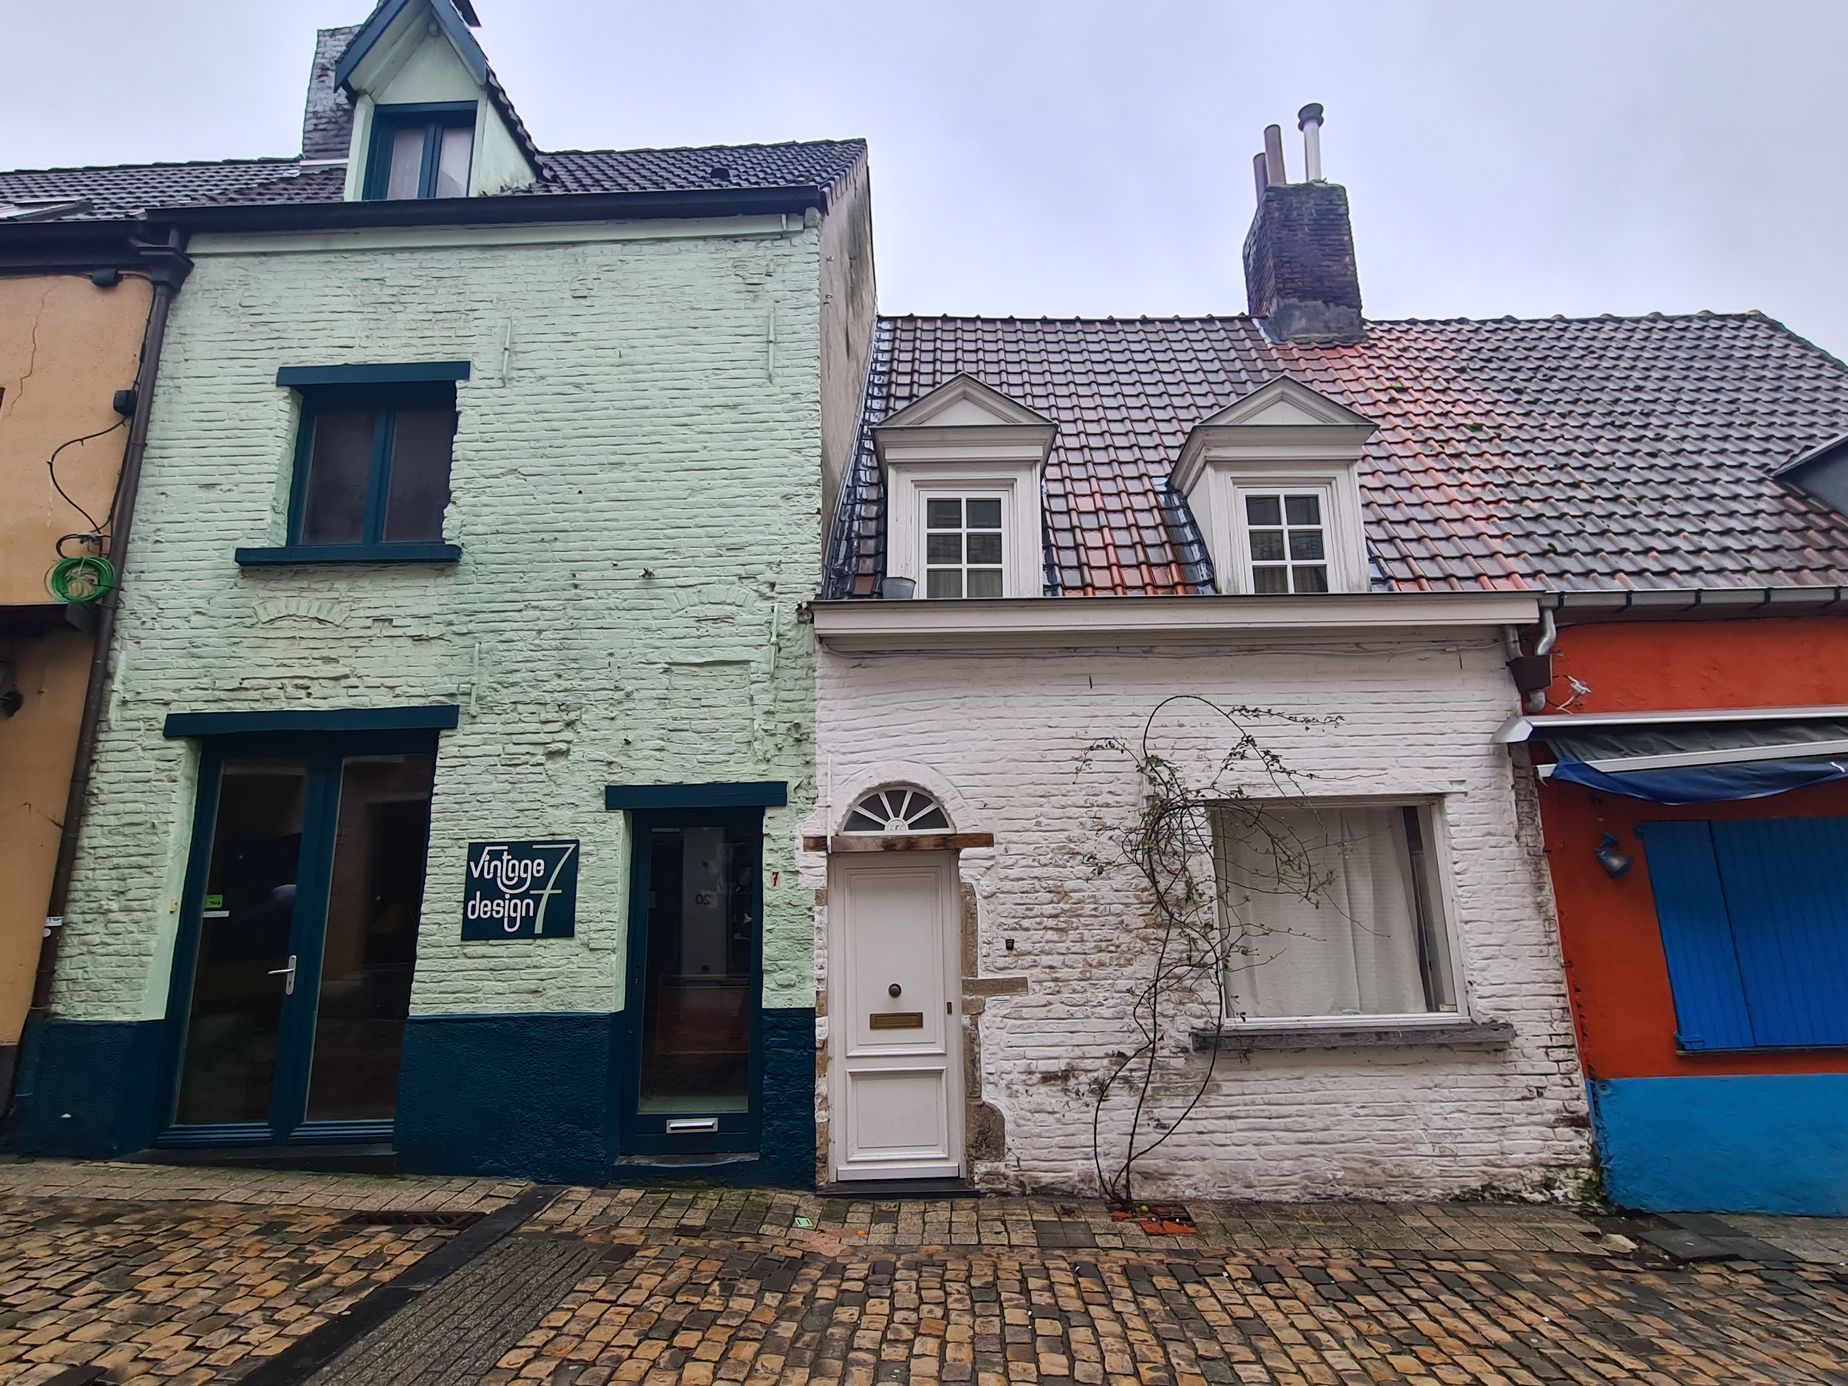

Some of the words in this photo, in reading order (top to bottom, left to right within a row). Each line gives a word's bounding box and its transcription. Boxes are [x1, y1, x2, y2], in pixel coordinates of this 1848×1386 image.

[531, 844, 577, 934] 7
[772, 872, 779, 887] 7
[467, 891, 534, 932] design
